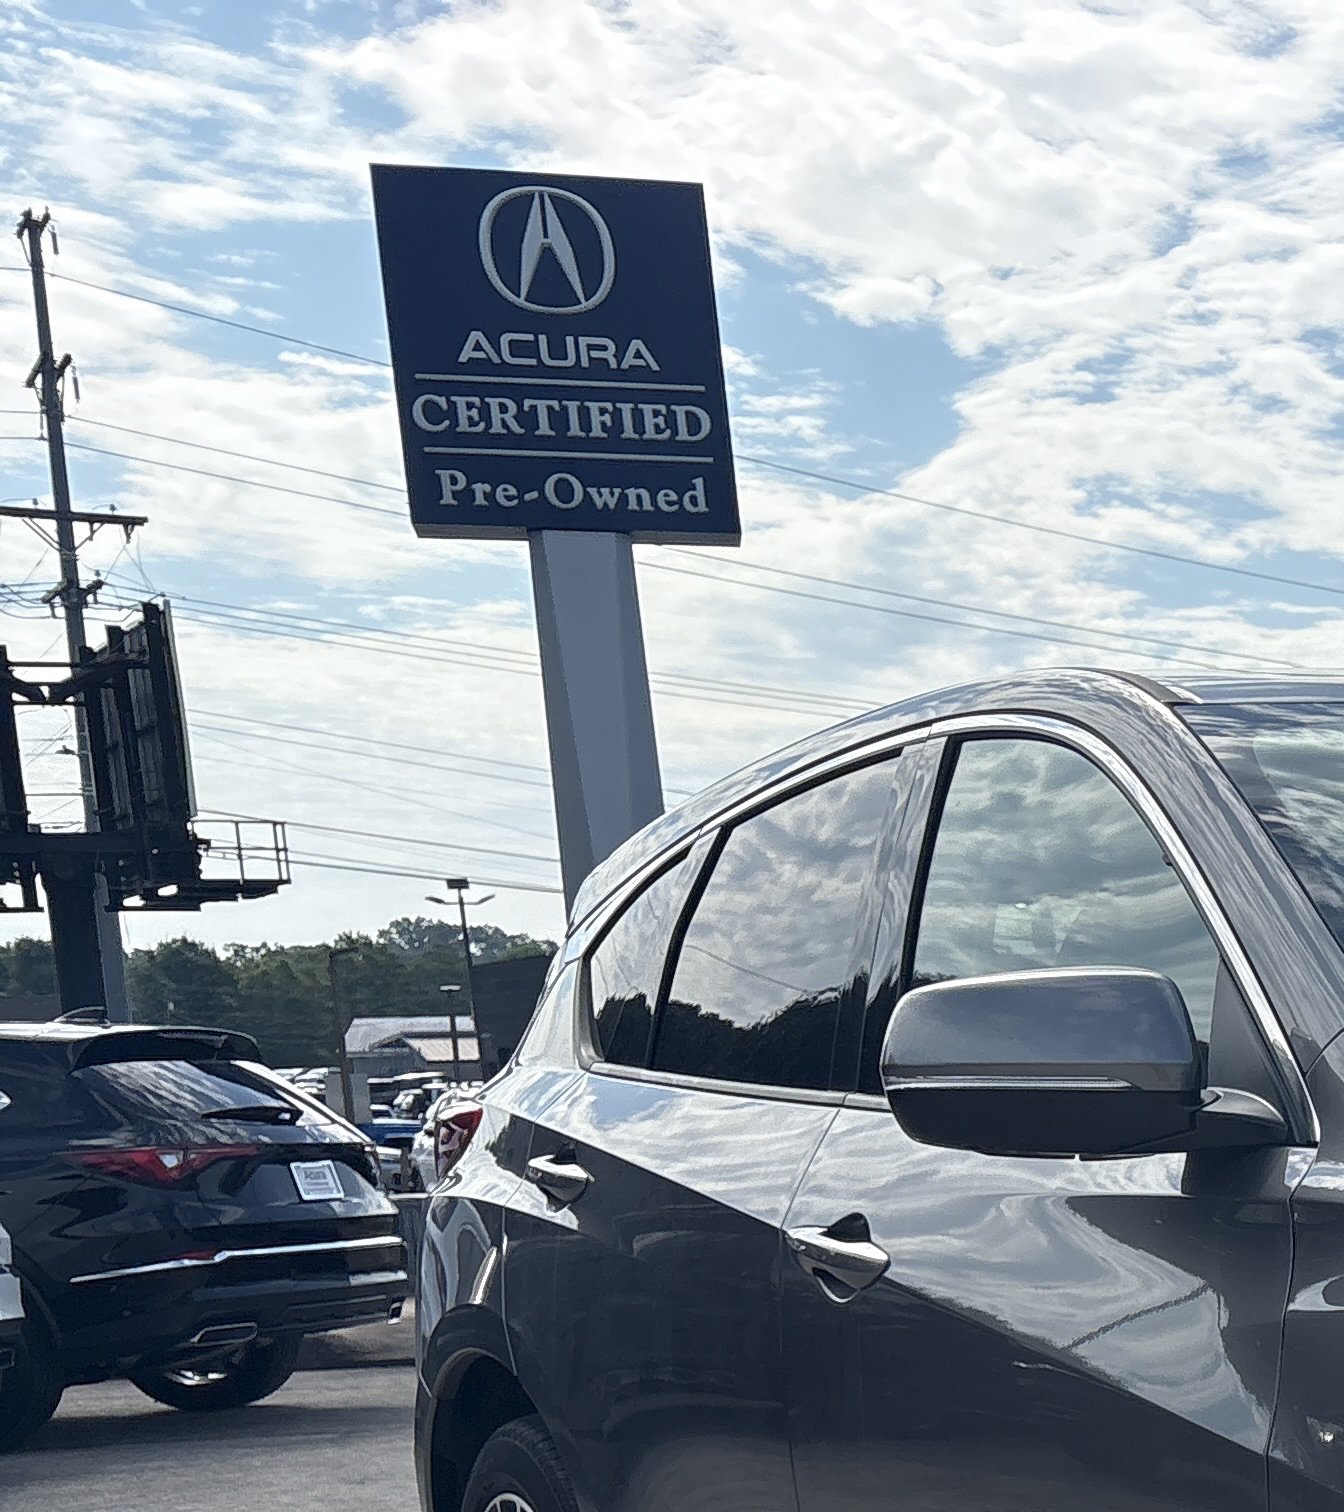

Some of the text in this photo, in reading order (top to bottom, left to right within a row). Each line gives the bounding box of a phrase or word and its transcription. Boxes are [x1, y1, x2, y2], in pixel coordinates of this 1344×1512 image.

[457, 330, 661, 371] ACURA
[411, 394, 712, 442] CERTIFIED
[434, 468, 709, 513] Pre-Owned
